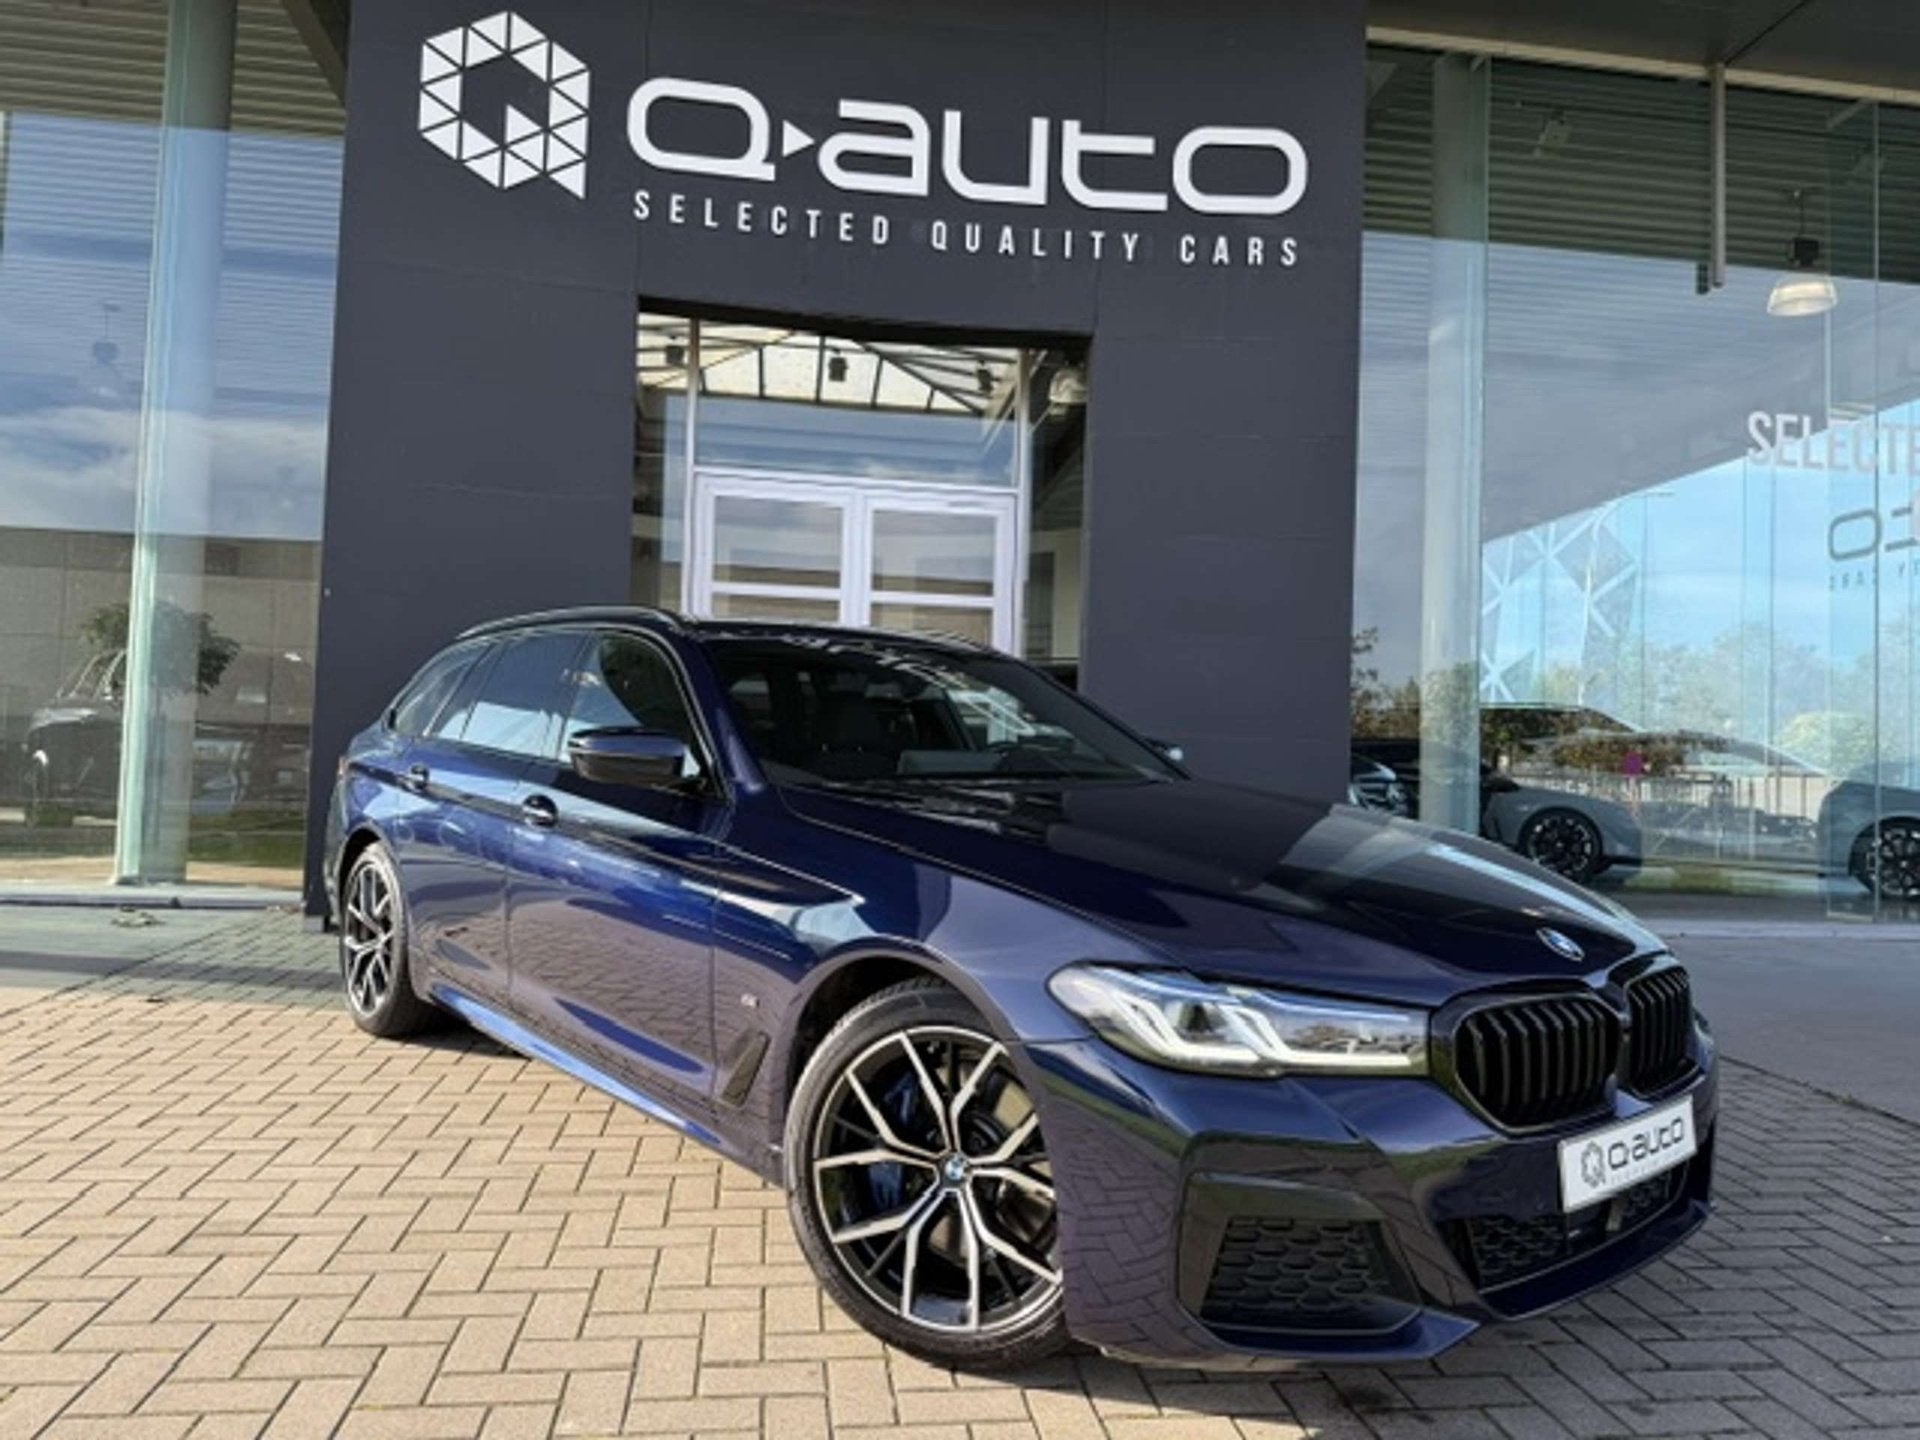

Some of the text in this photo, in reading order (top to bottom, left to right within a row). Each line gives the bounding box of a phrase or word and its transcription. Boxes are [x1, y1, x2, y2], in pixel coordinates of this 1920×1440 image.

[633, 189, 1297, 266] SELECTED QUALITY CARS
